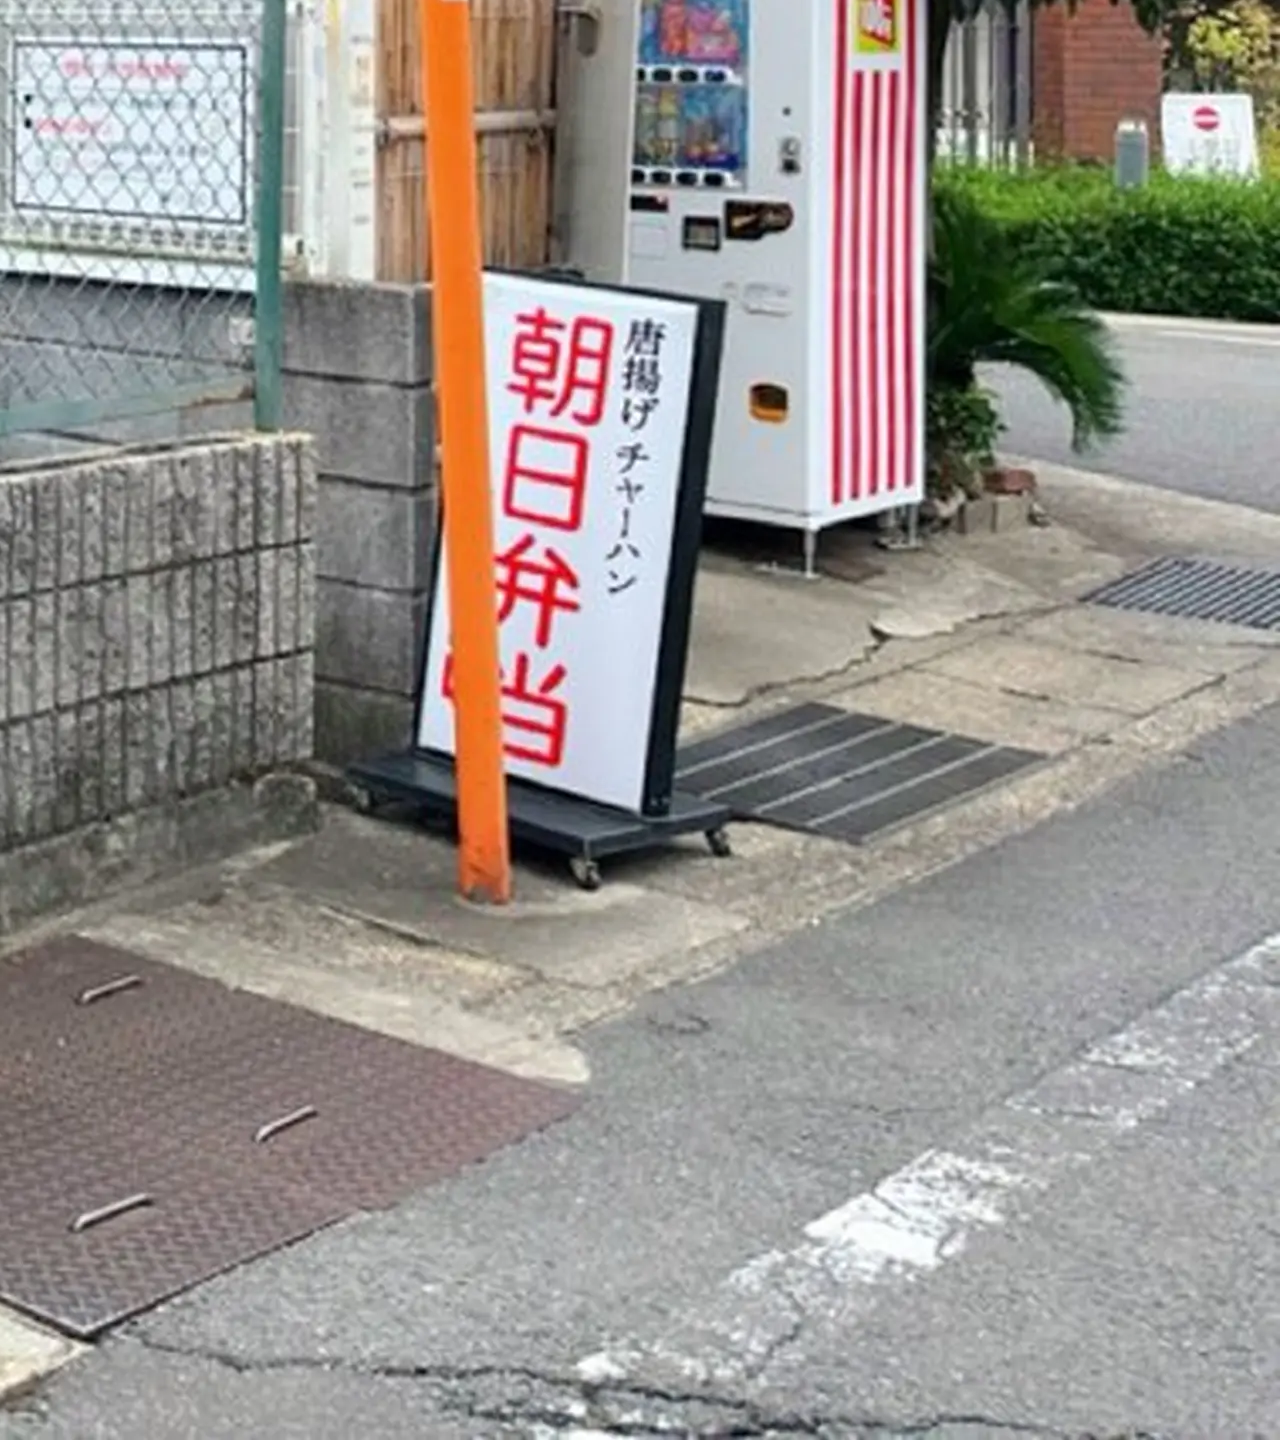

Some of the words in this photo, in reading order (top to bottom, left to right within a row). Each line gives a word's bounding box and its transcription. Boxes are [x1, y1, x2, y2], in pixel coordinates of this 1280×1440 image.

[620, 317, 667, 434] 唐揚げ
[495, 305, 615, 769] 朝日弁当
[604, 440, 651, 597] チャーハン
